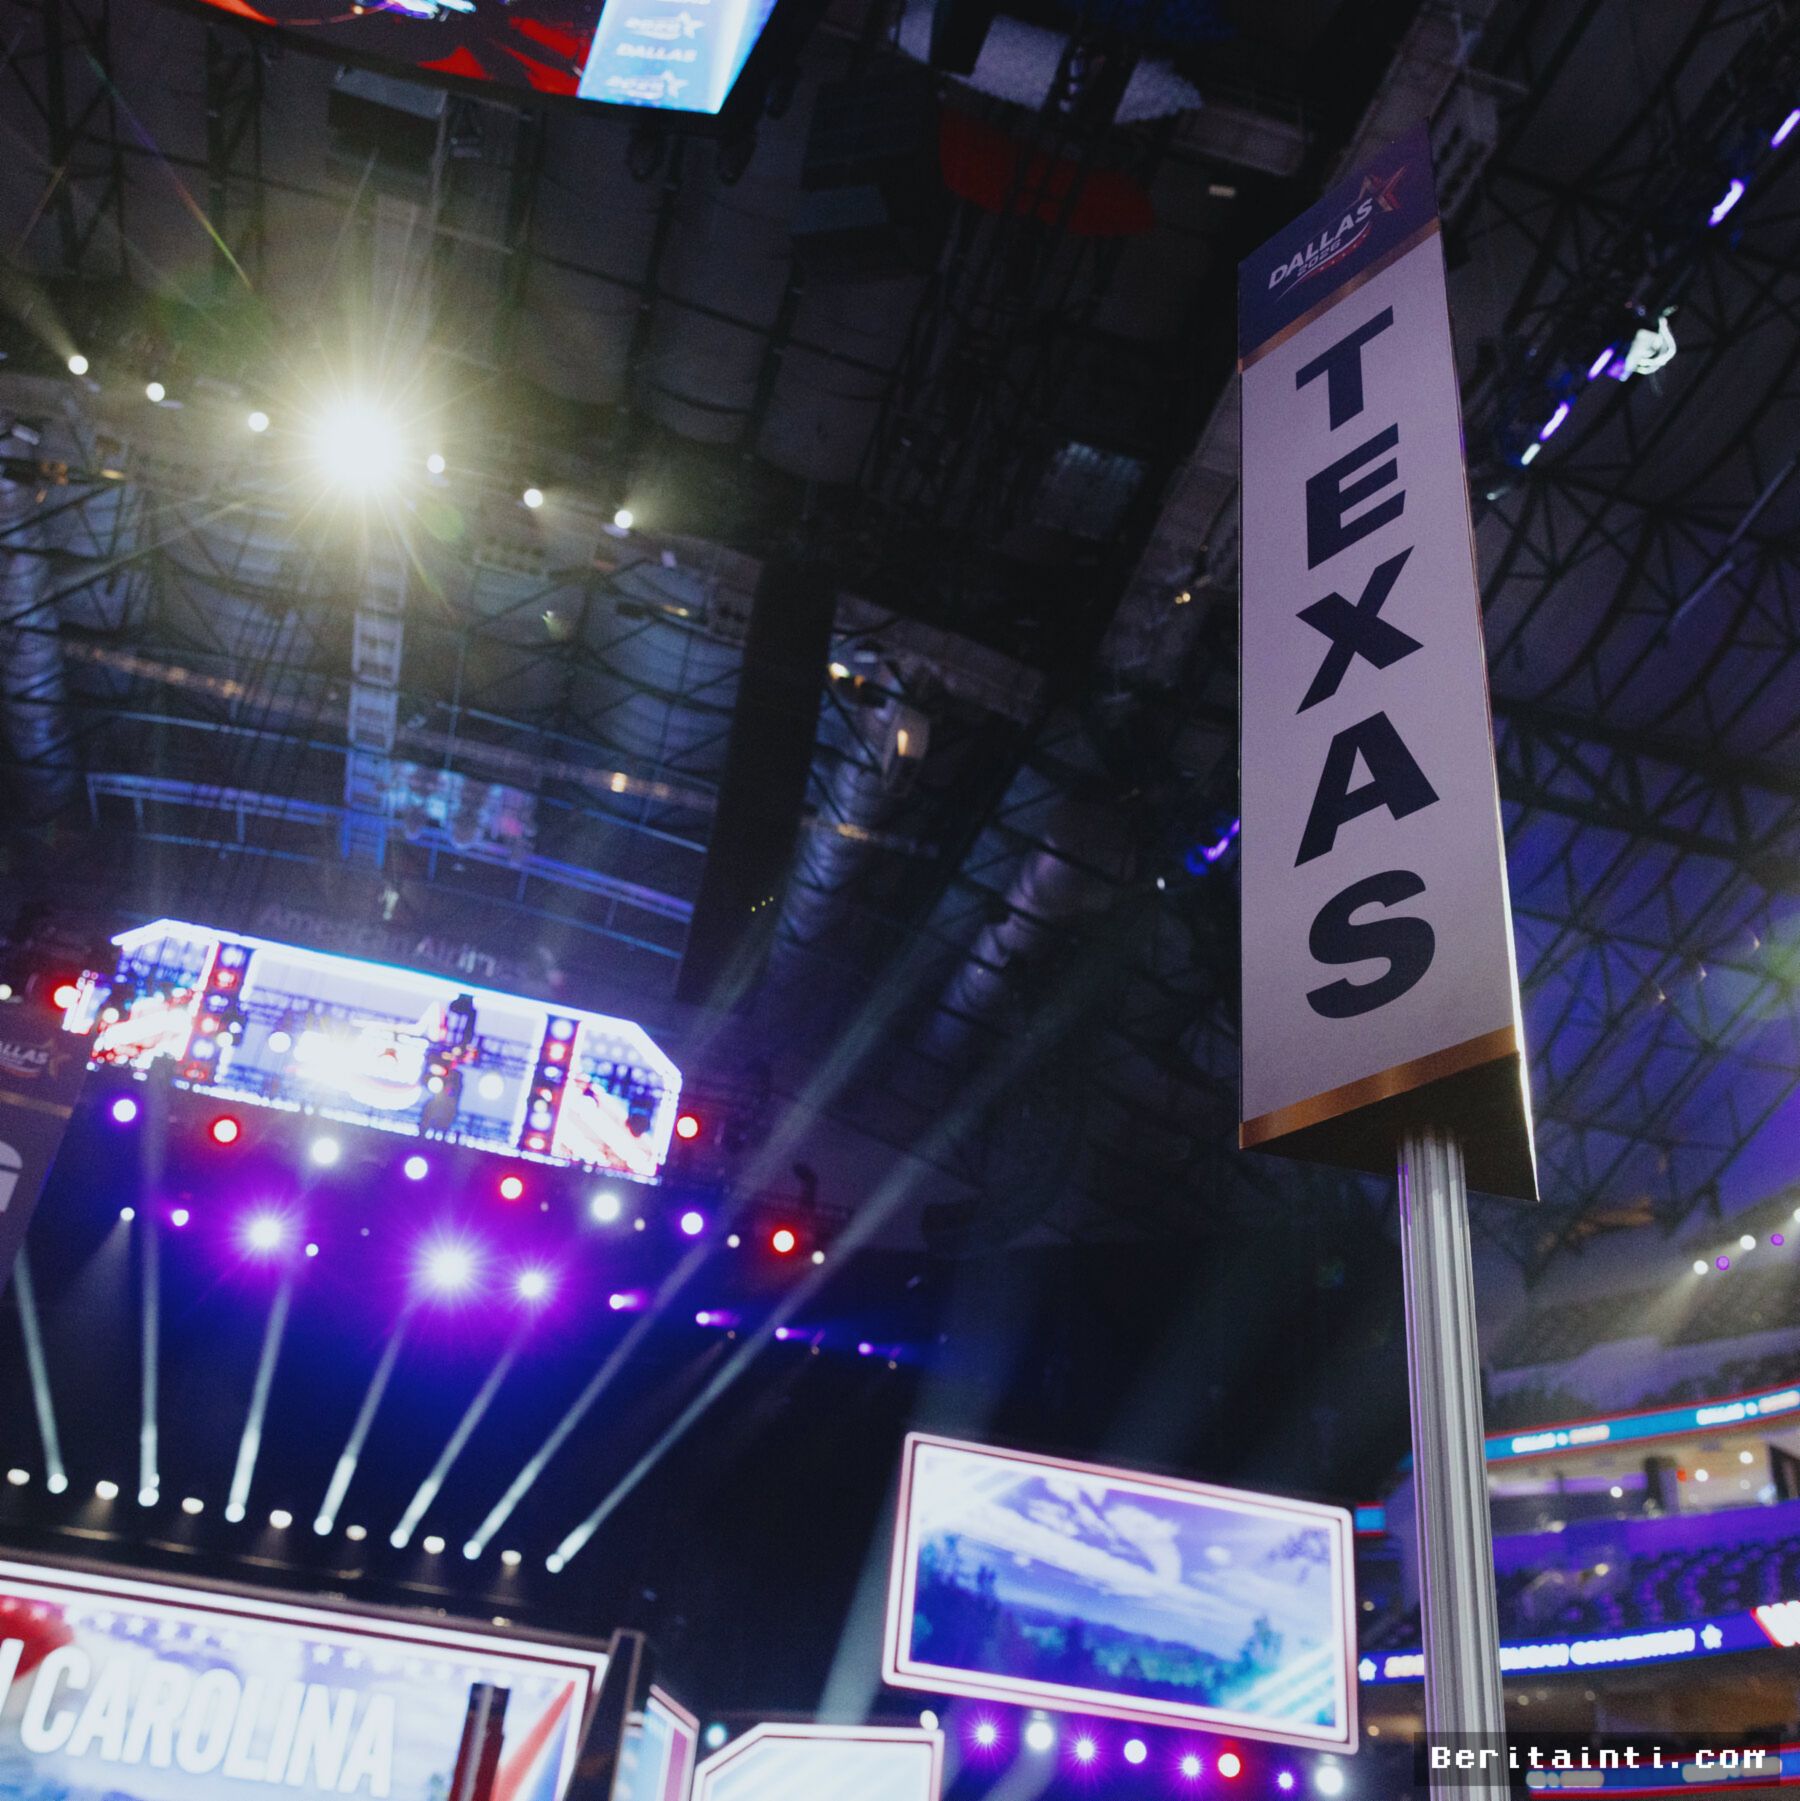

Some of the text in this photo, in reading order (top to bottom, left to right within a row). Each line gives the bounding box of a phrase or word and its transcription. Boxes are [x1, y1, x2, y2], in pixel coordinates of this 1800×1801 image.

[1268, 198, 1373, 290] DALLAS
[1298, 239, 1342, 274] 2026
[1294, 305, 1440, 1018] TEXAS
[20, 1645, 396, 1798] CAROLINA
